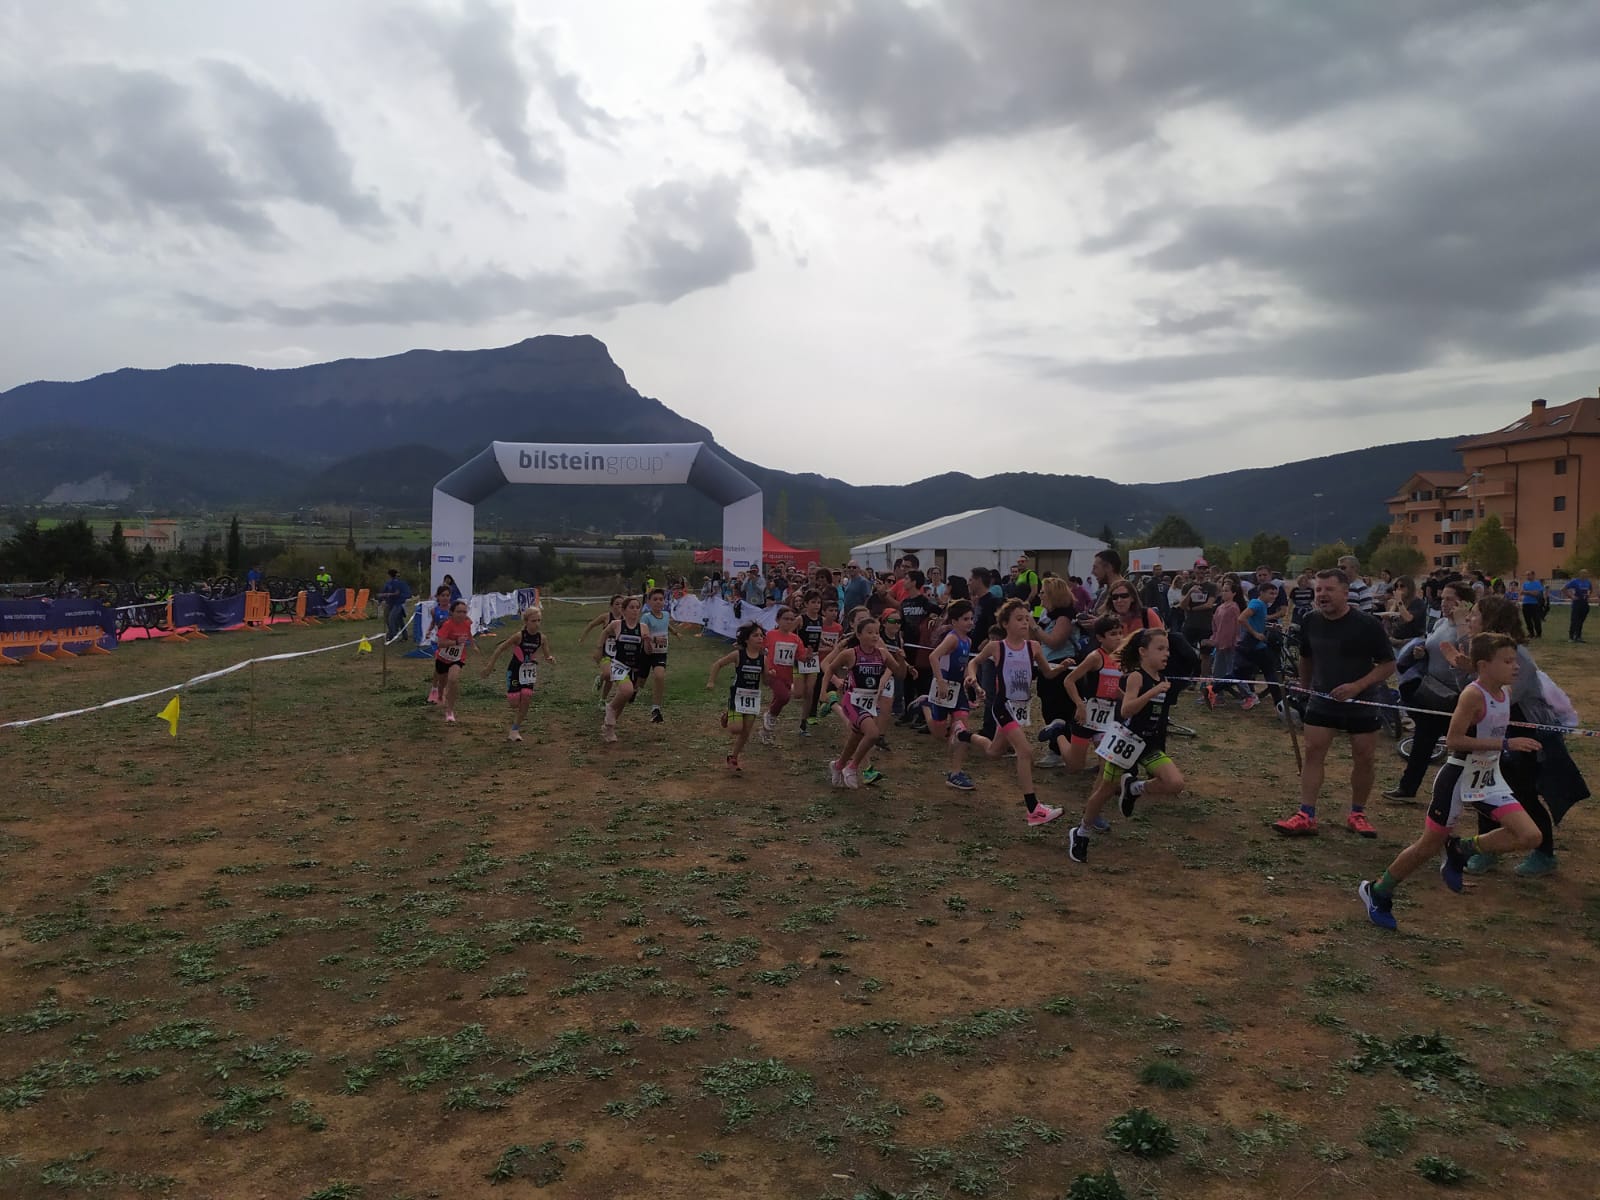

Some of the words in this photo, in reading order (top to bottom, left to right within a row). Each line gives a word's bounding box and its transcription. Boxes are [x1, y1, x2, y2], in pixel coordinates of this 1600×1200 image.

[740, 696, 755, 708] 191
[855, 697, 874, 710] 176
[1107, 735, 1136, 759] 188
